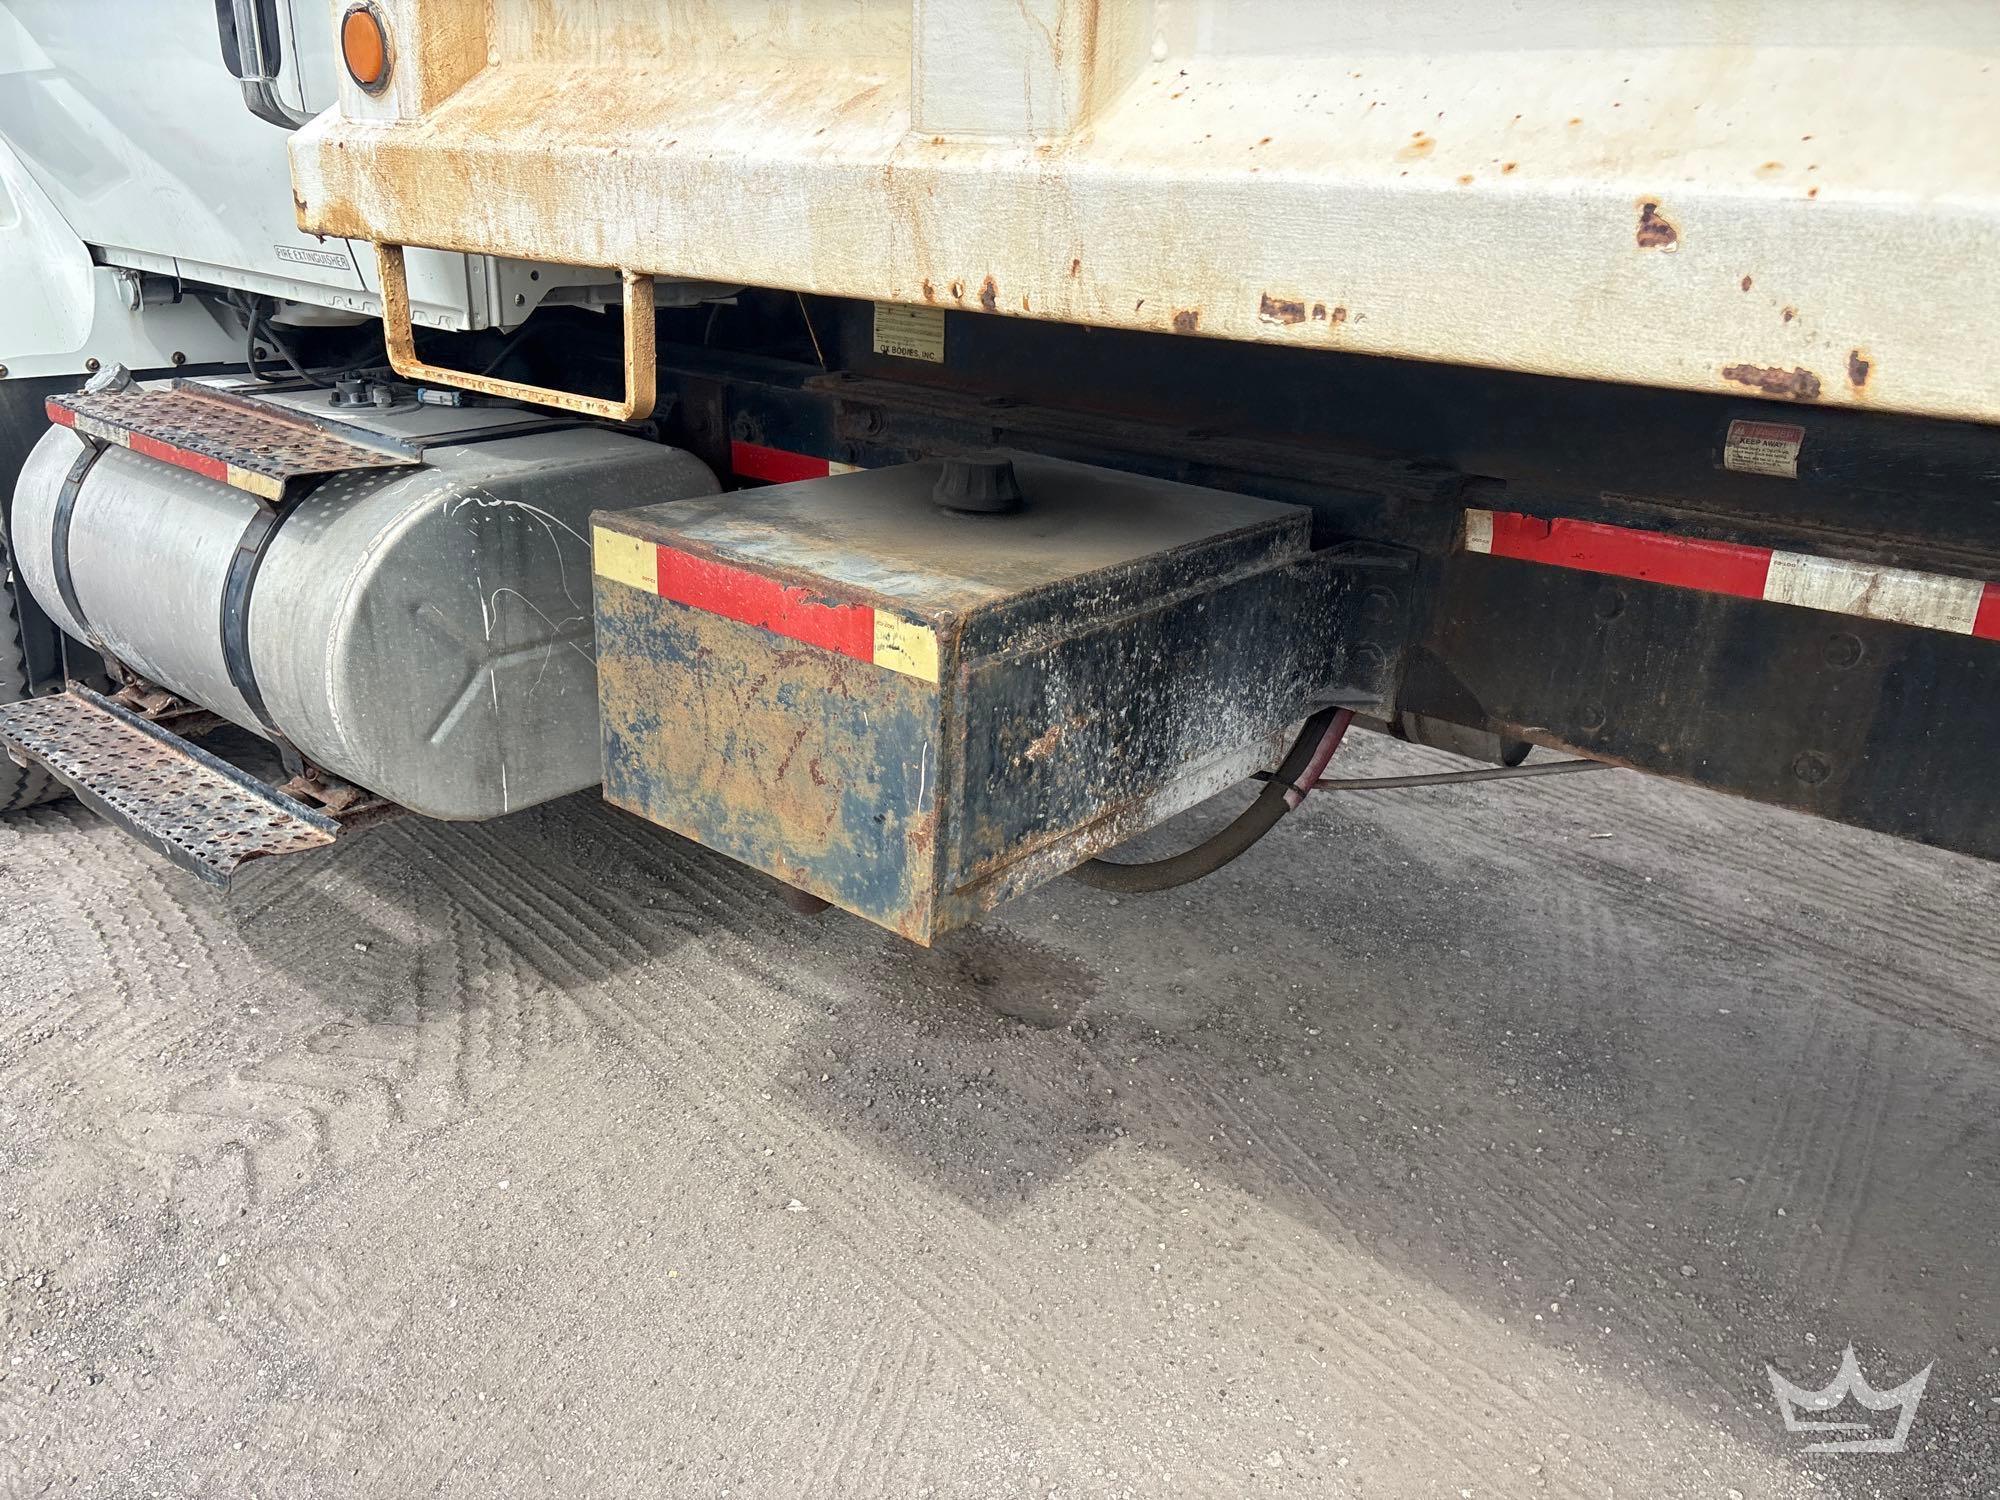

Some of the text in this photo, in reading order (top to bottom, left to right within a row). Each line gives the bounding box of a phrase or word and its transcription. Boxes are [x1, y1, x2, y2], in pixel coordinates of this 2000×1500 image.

[276, 247, 348, 267] FIRE EXTINGUISHER
[1739, 437, 1761, 446] KEEP
